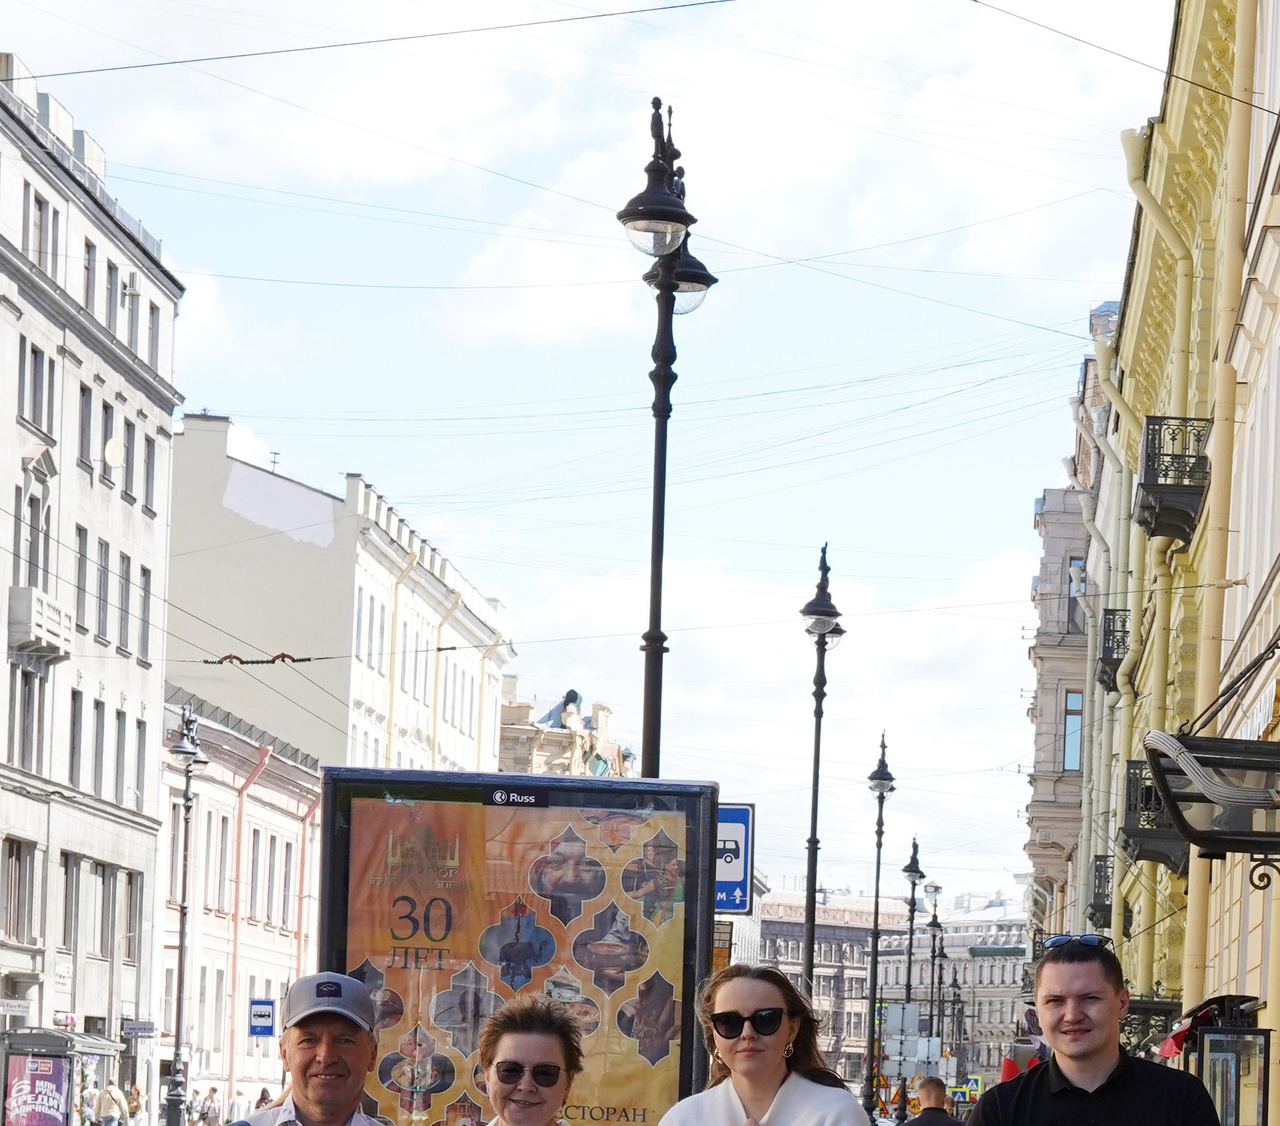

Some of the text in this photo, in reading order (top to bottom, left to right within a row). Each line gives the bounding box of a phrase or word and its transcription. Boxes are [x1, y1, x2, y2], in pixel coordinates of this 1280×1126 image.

[509, 793, 536, 803] Russ
[390, 895, 453, 943] 30
[387, 946, 450, 971] ЛЕТ
[35, 1080, 56, 1091] МЛН
[555, 1105, 648, 1123] ЕСТОРАН
